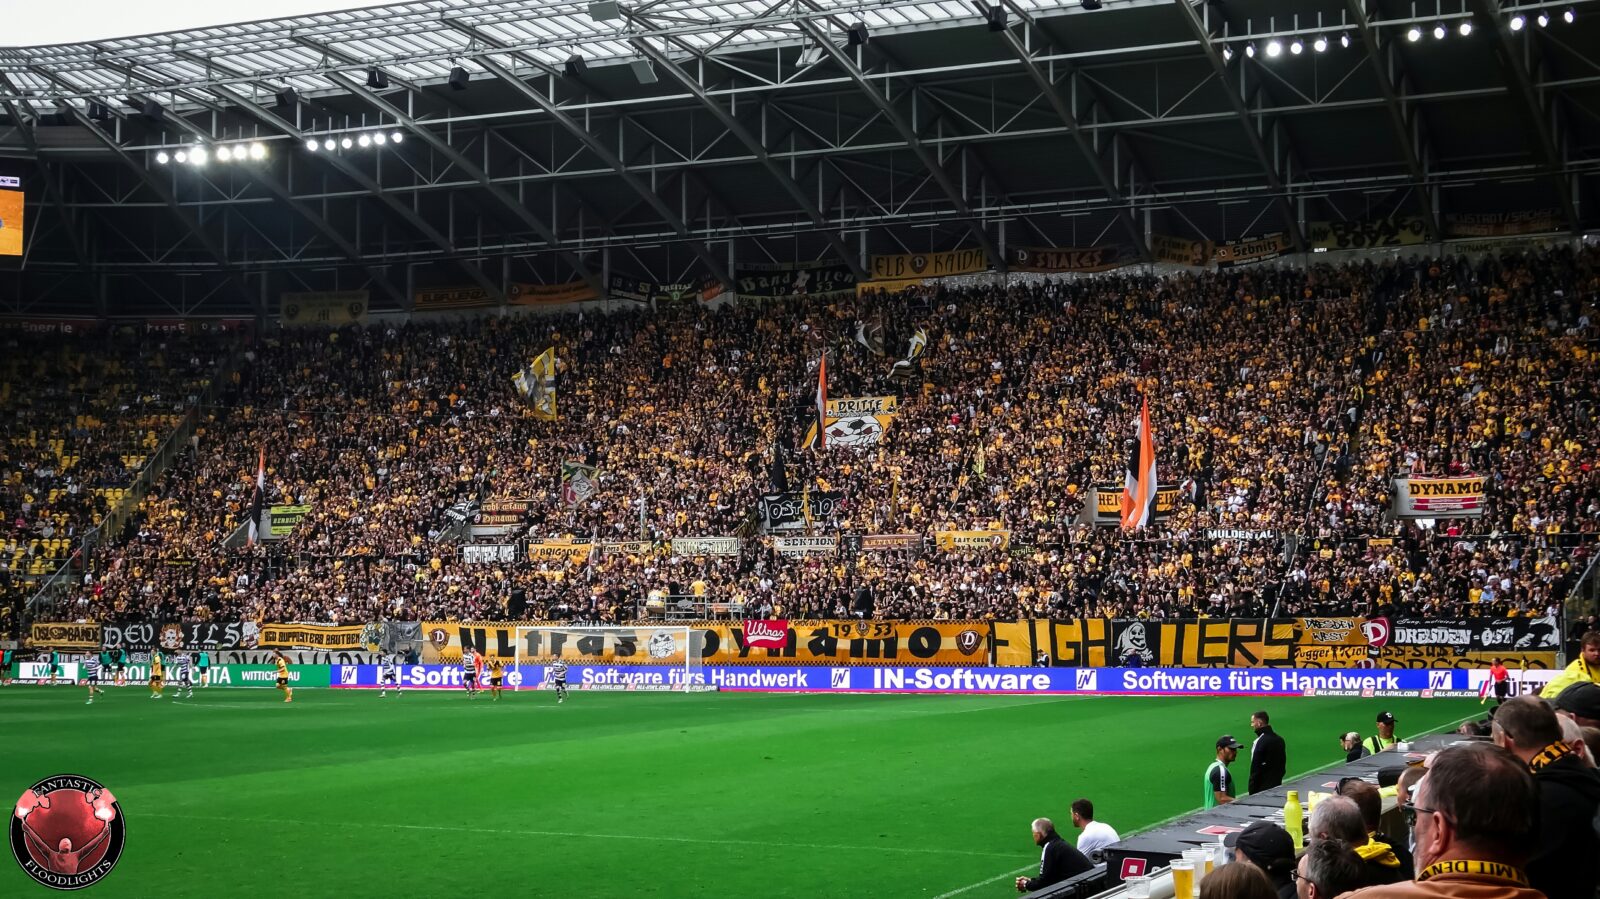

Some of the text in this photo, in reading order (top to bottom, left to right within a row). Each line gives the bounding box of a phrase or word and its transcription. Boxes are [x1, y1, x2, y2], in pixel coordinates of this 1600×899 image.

[1231, 241, 1277, 258] Sebnitz
[874, 256, 905, 277] ELB
[933, 249, 984, 274] KAIDA
[838, 399, 883, 413] DRITTE
[1409, 482, 1482, 495] DYNAMO
[783, 538, 834, 546] SEKTION
[746, 620, 785, 637] Ultras
[832, 623, 851, 638] 19
[874, 623, 892, 637] 53
[1304, 618, 1354, 630] DRESDEN
[241, 670, 300, 682] WITTICHAU
[377, 666, 523, 686] I-Softare
[582, 667, 808, 687] Software fürs Handwerk
[873, 668, 1050, 690] IN-Software
[1123, 670, 1400, 690] Software fürs Handwerk
[1432, 860, 1468, 876] DEN
[1476, 861, 1513, 879] MIT
